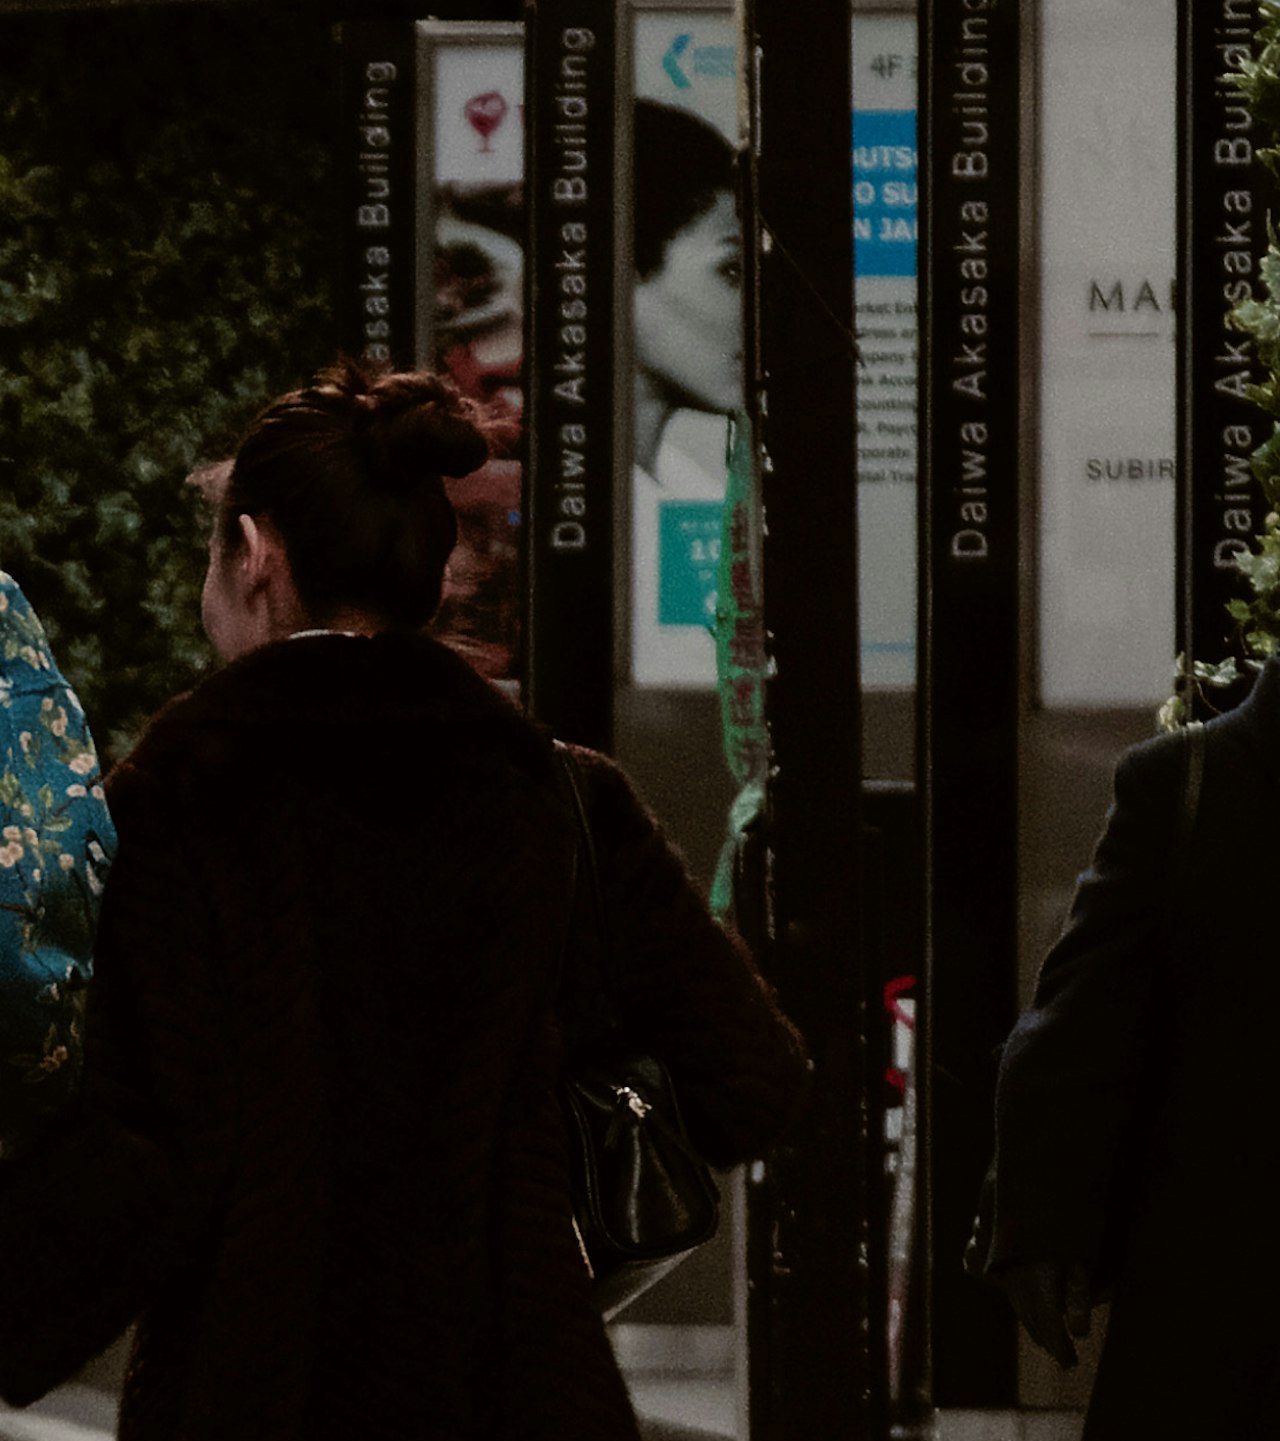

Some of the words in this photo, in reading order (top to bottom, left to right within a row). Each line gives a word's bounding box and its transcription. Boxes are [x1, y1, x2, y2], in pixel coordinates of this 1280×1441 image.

[358, 61, 398, 227] Building
[553, 25, 596, 203] Building
[358, 245, 391, 362] asaka
[553, 217, 589, 405] Akasaka
[952, 196, 989, 401] Akasaka
[1088, 278, 1177, 313] MA
[553, 425, 589, 551] Daiwa
[952, 423, 989, 562] Daiwa
